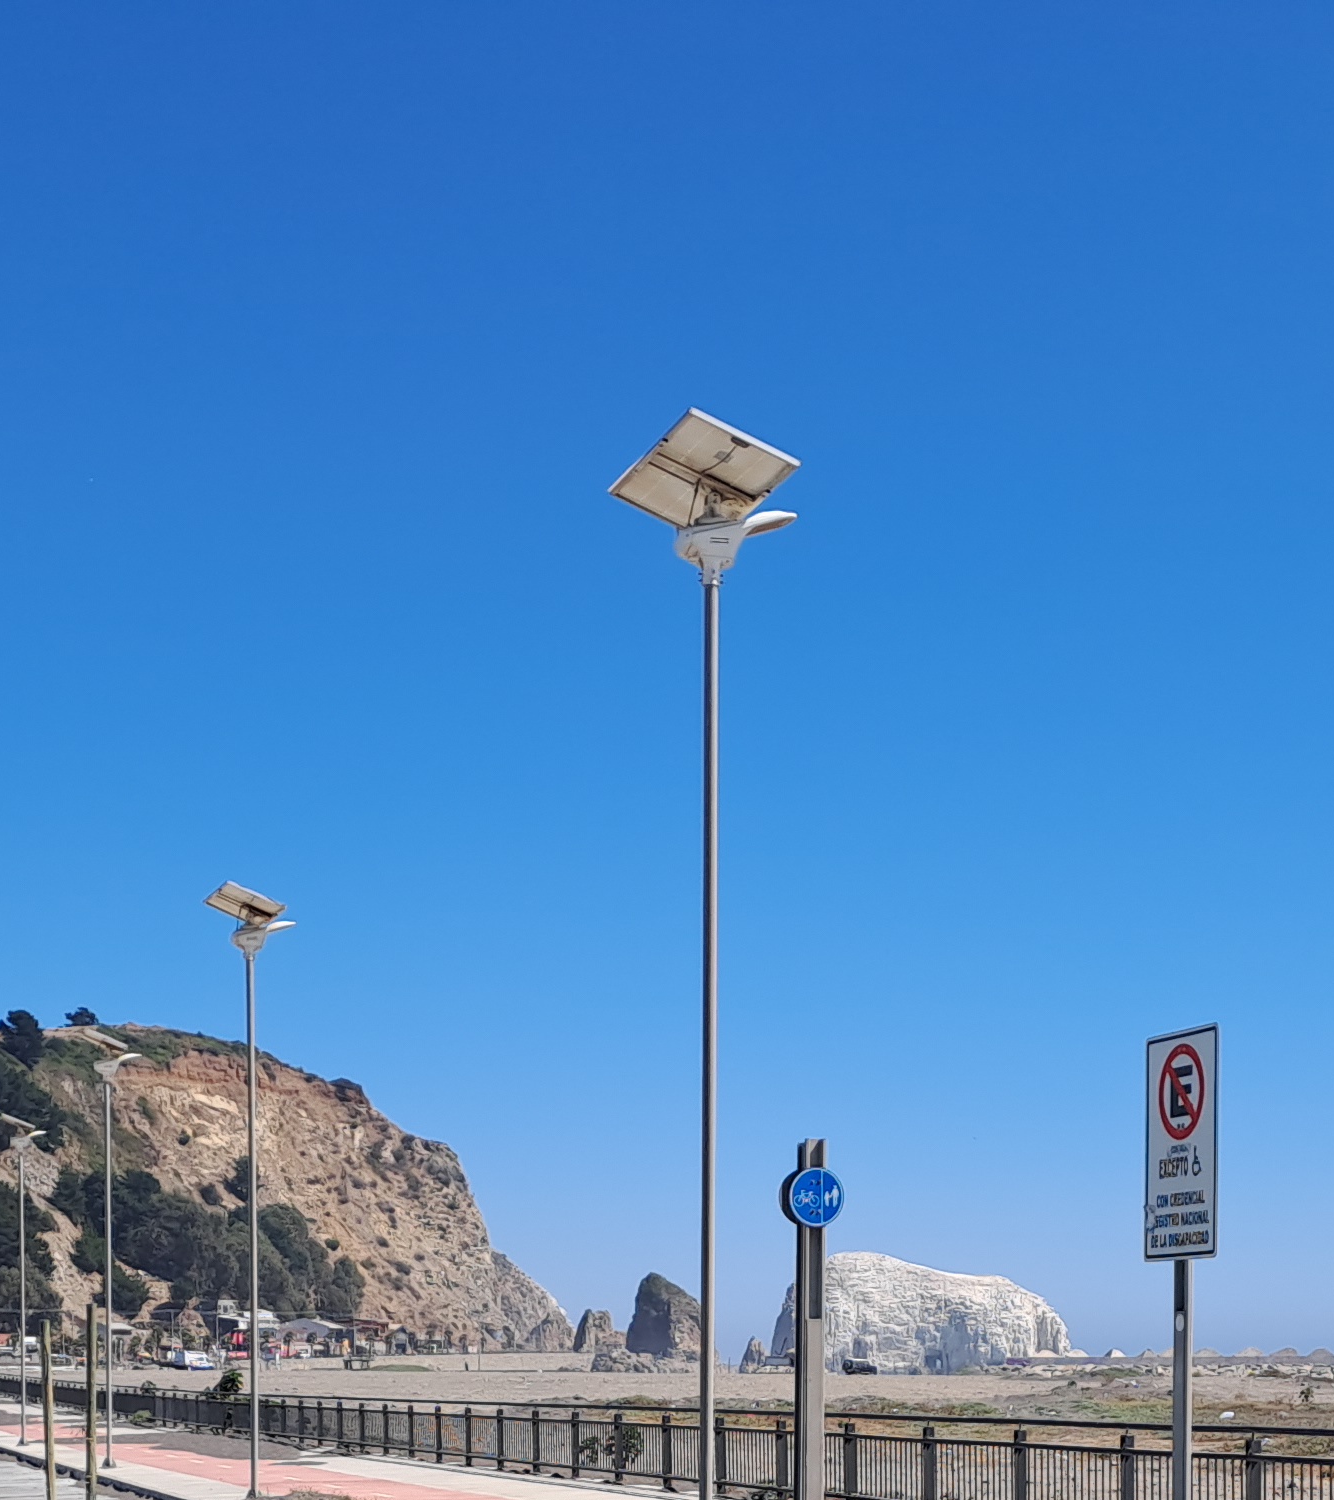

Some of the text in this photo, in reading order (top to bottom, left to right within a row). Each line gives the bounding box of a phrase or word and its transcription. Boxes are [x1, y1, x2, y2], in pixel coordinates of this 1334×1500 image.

[1170, 1065, 1194, 1118] E
[1159, 1156, 1189, 1180] EXCEPTO
[1156, 1190, 1206, 1208] CON CREDENCIAL
[1181, 1210, 1210, 1226] NACIONAL
[1151, 1230, 1210, 1248] DE LA DISCAPACIDAD
